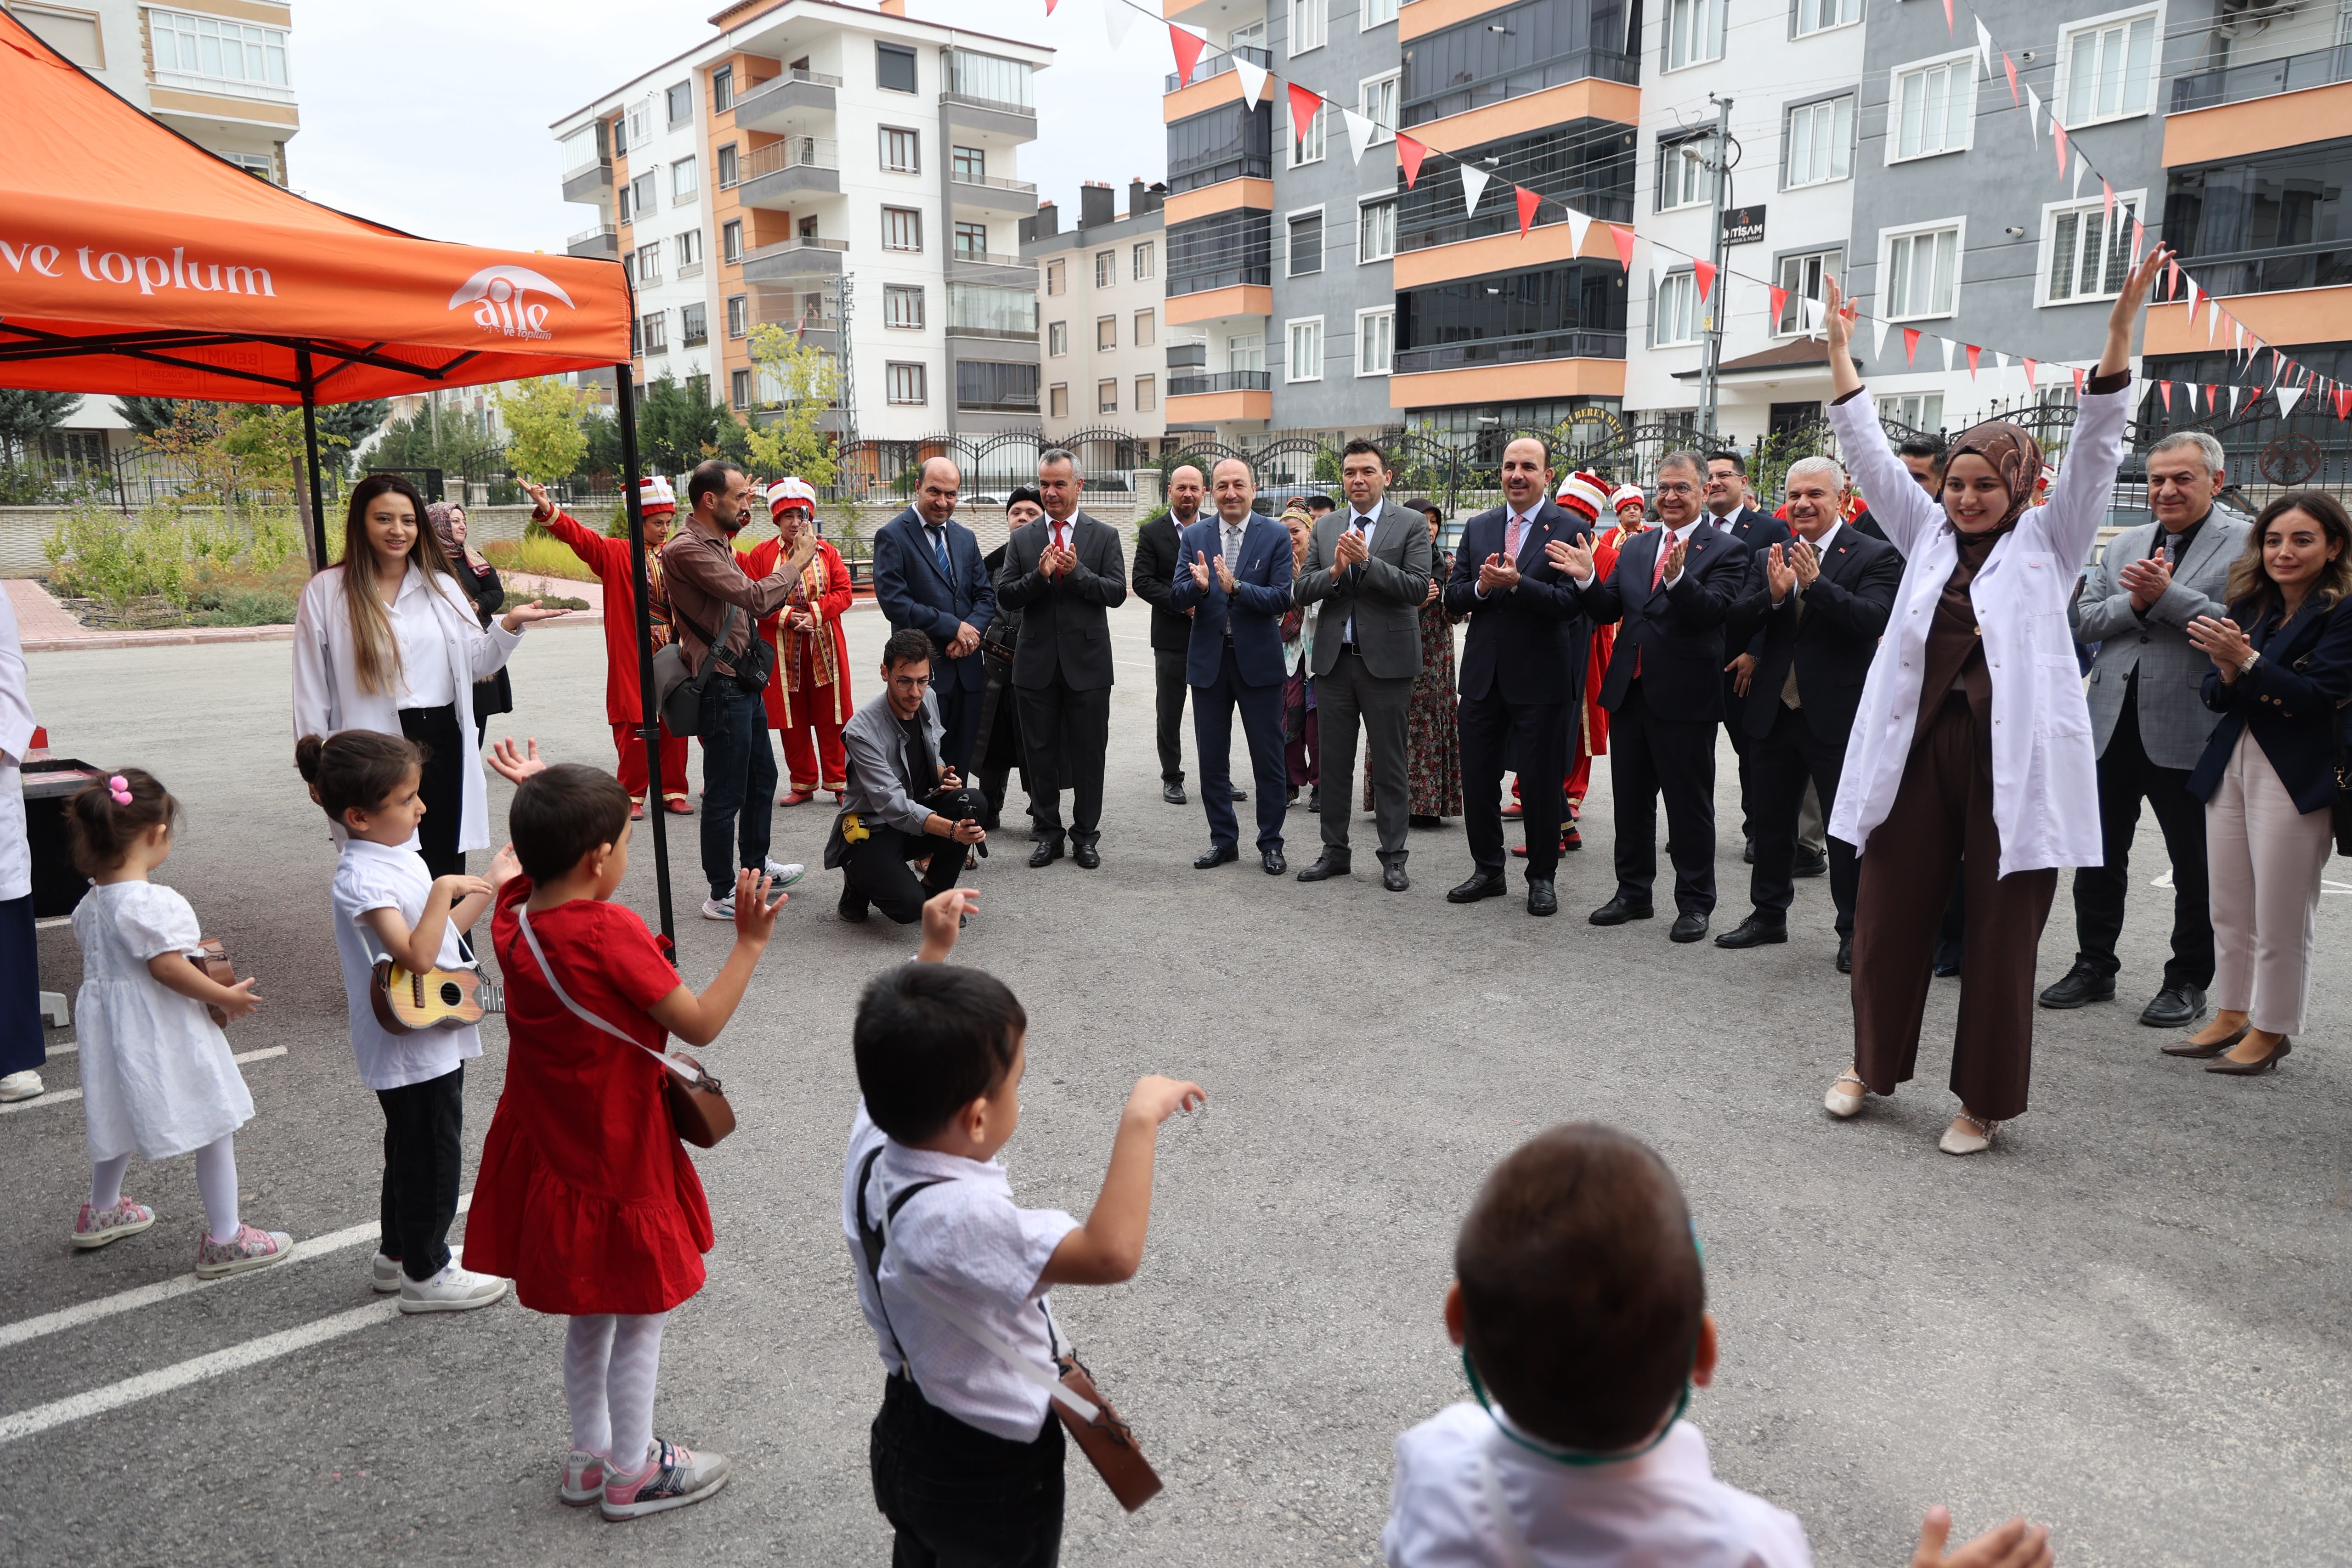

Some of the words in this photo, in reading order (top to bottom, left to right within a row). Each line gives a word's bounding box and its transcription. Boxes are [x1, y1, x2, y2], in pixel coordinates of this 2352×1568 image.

[0, 240, 63, 276] ve
[76, 246, 277, 295] toplum
[474, 282, 551, 333] aile
[503, 327, 515, 336] ve
[517, 329, 552, 341] toplum
[1574, 407, 1607, 420] BEREN
[756, 671, 768, 683] NIKE
